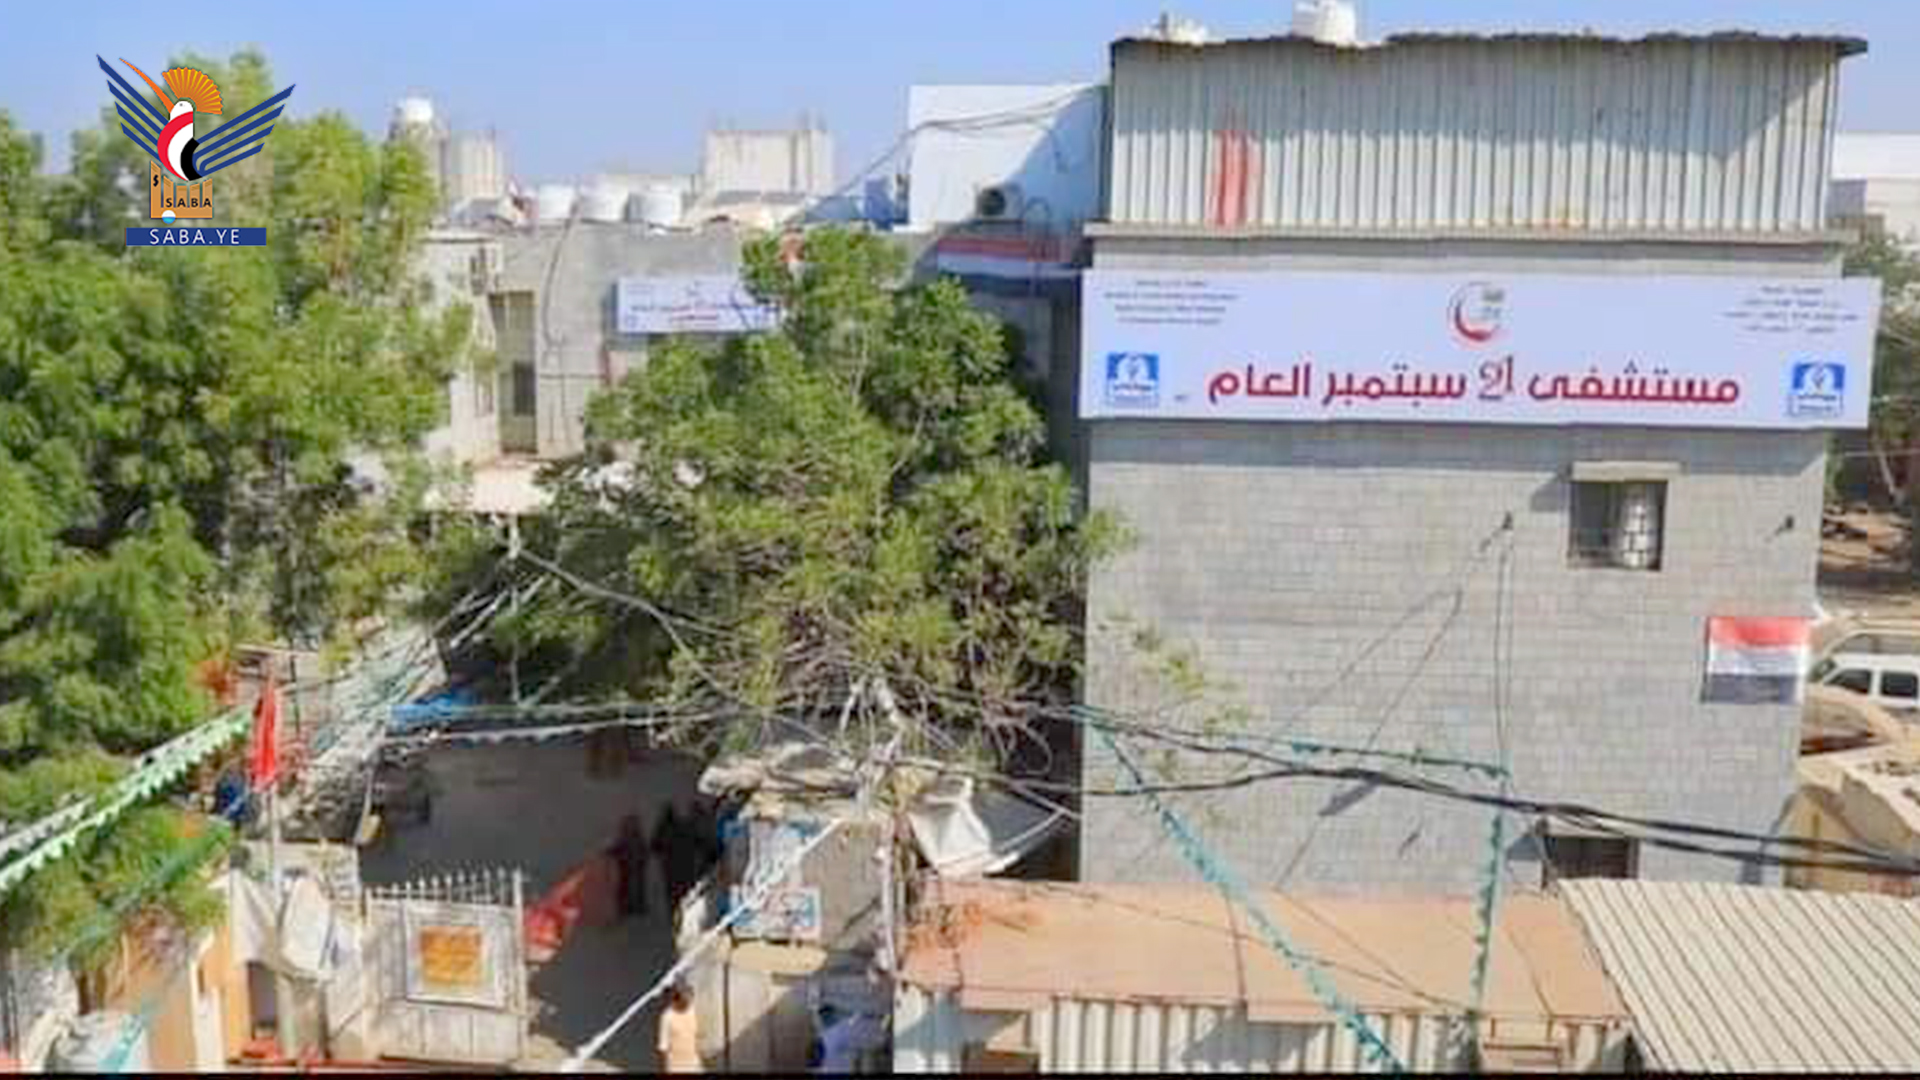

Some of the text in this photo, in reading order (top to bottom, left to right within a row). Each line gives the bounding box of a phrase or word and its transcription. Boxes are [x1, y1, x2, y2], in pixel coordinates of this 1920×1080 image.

[1208, 362, 1312, 405] العام
[1321, 362, 1466, 407] سبتمبر
[1527, 360, 1740, 405] مستشفى
